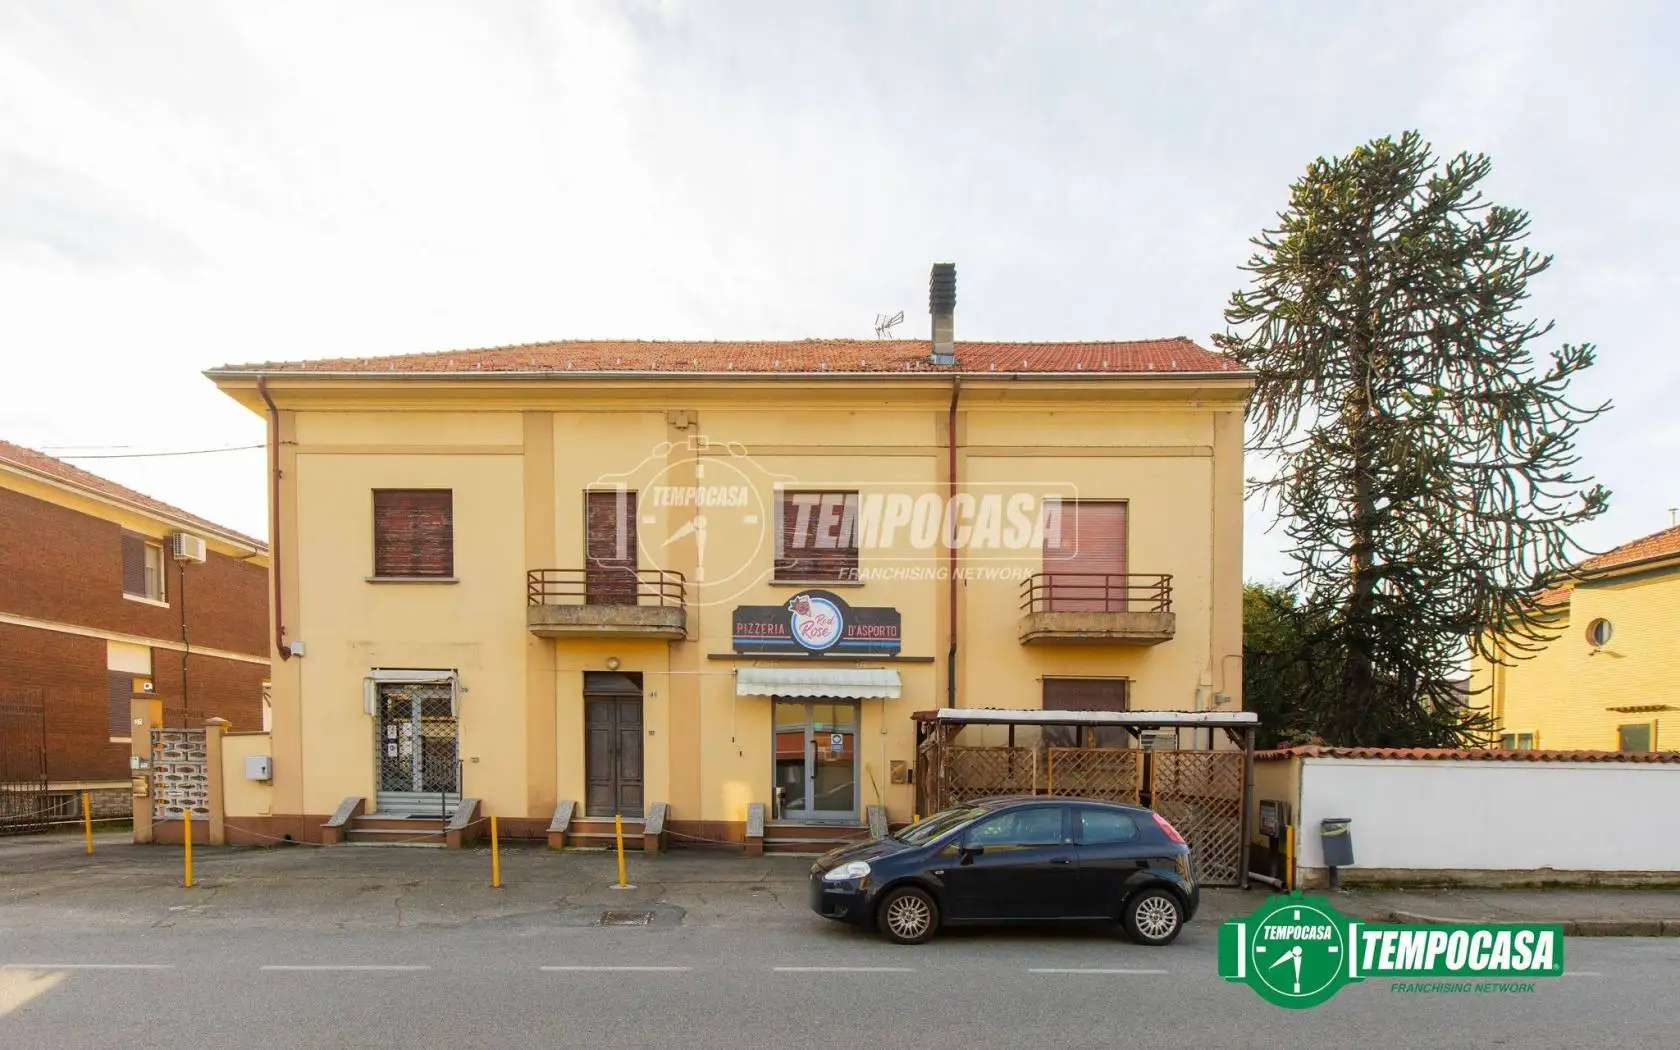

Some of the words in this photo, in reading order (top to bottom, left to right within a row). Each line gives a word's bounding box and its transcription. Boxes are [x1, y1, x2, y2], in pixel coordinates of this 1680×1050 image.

[814, 613, 836, 625] Red
[736, 623, 785, 635] PIZZERIA
[800, 620, 831, 639] Rose
[848, 625, 897, 637] D'ASPORTO
